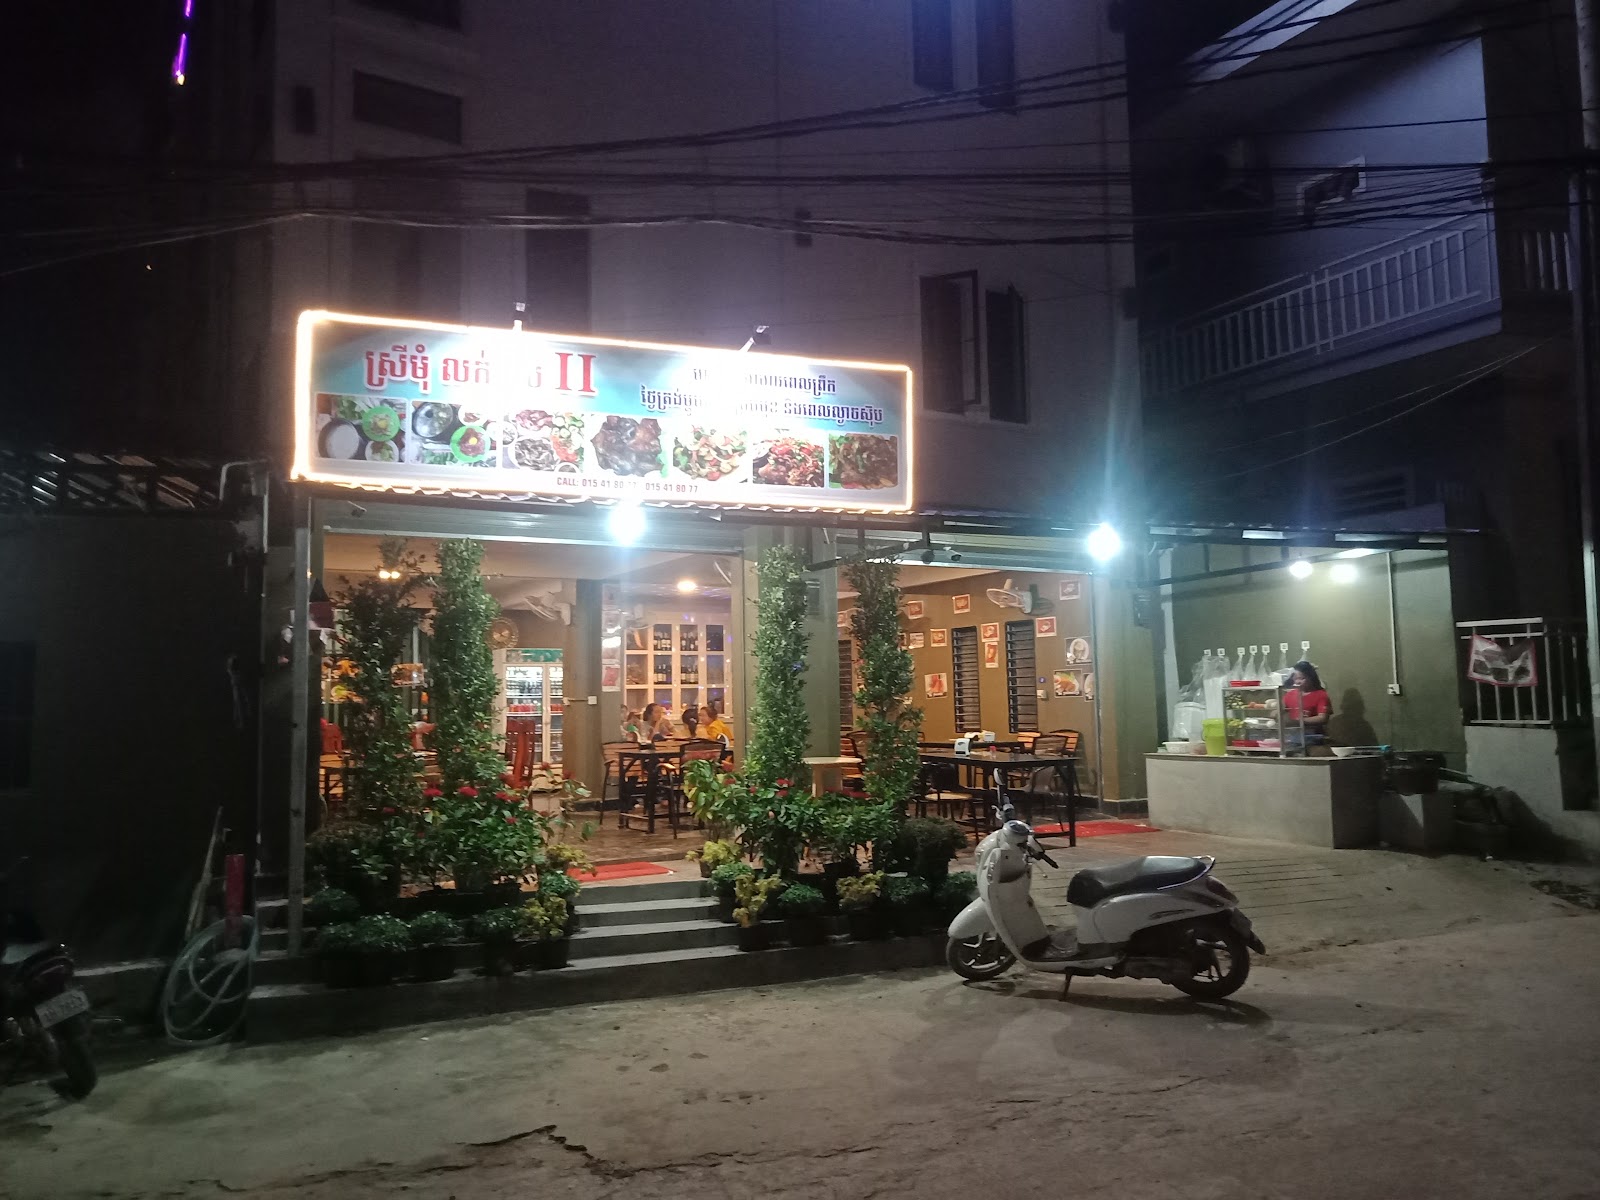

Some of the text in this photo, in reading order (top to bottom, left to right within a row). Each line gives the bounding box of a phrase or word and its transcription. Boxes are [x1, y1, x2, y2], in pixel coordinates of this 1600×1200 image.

[366, 344, 429, 390] ស្រីមុំ
[557, 477, 579, 487] CALL:
[582, 479, 598, 488] 015
[600, 480, 611, 488] 41
[645, 482, 698, 493] 015 41 80 77
